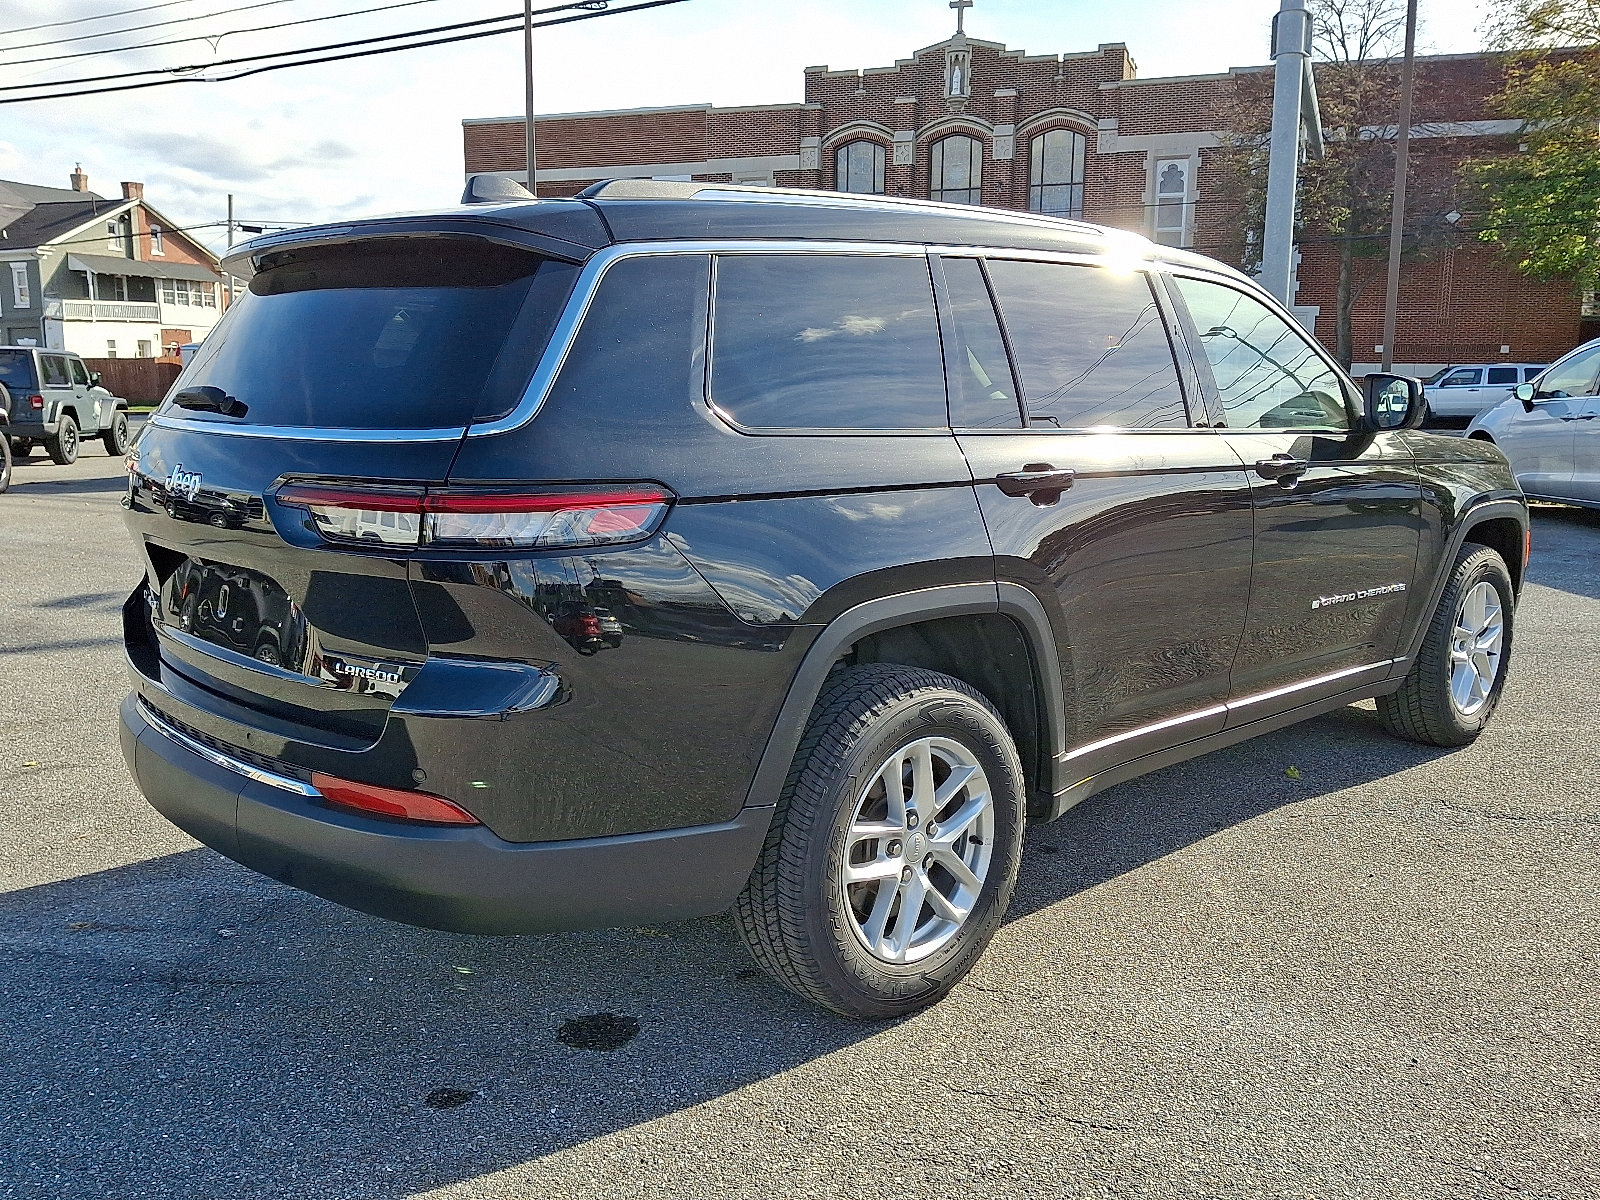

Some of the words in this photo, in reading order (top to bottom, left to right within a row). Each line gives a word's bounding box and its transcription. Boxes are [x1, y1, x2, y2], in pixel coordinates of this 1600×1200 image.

[165, 463, 203, 502] Jeep
[1320, 593, 1356, 607] GRAND
[1356, 583, 1407, 599] CHEROKEE
[335, 662, 401, 684] LAREDO
